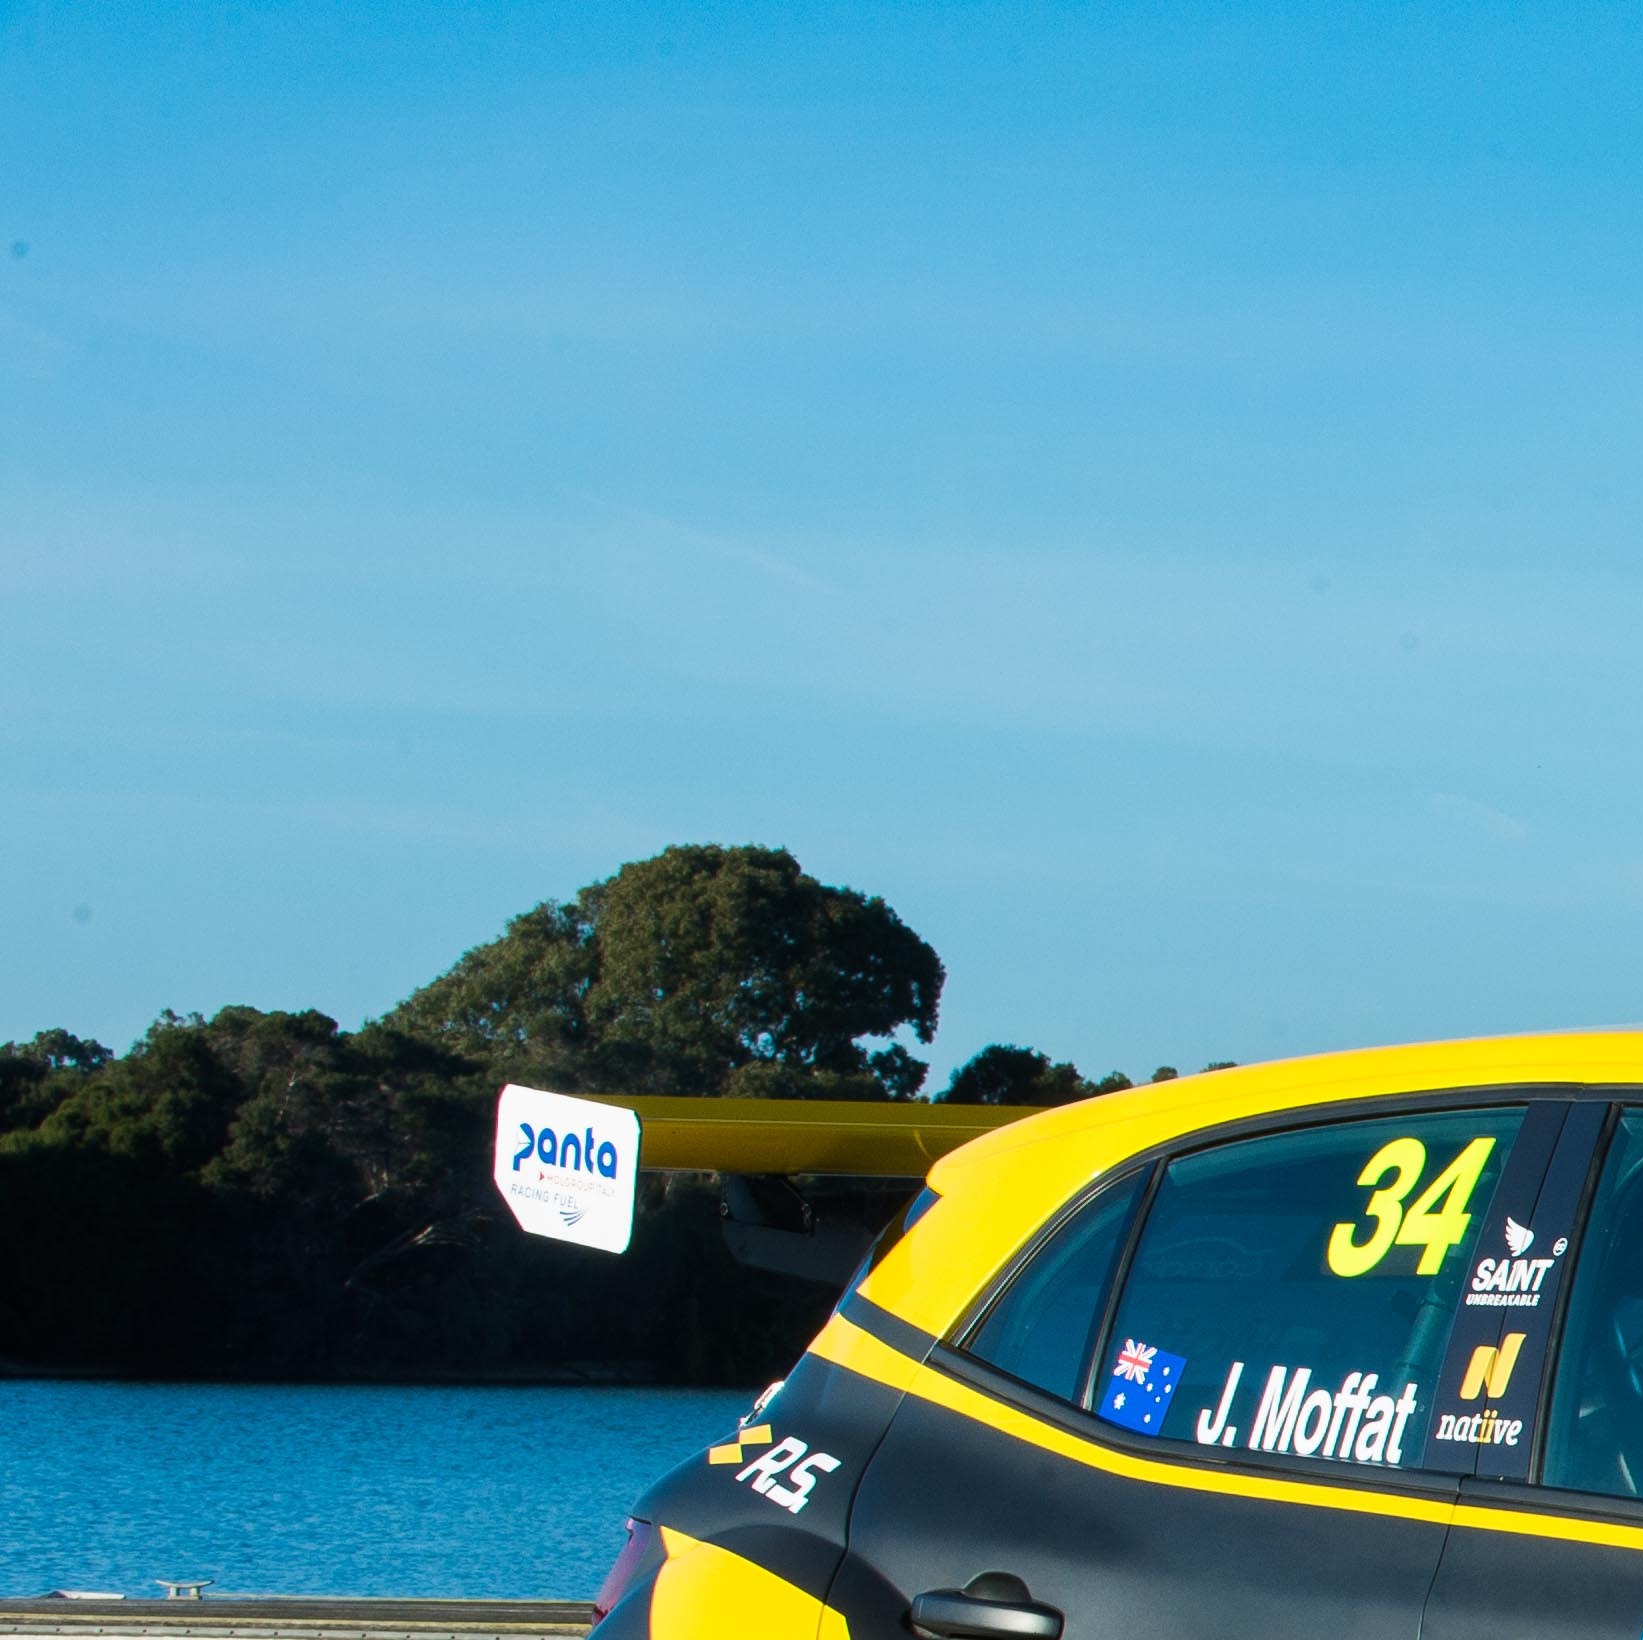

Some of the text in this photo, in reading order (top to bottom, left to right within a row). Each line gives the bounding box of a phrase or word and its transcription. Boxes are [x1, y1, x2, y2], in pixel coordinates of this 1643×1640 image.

[512, 1122, 618, 1180] panta
[510, 1183, 579, 1210] RACING FUEL
[1326, 1136, 1497, 1278] 34
[1471, 1257, 1555, 1292] SAINT
[1465, 1293, 1541, 1307] UNBREAKABLE
[1196, 1361, 1419, 1464] J. Moffat
[1435, 1409, 1523, 1446] natiive
